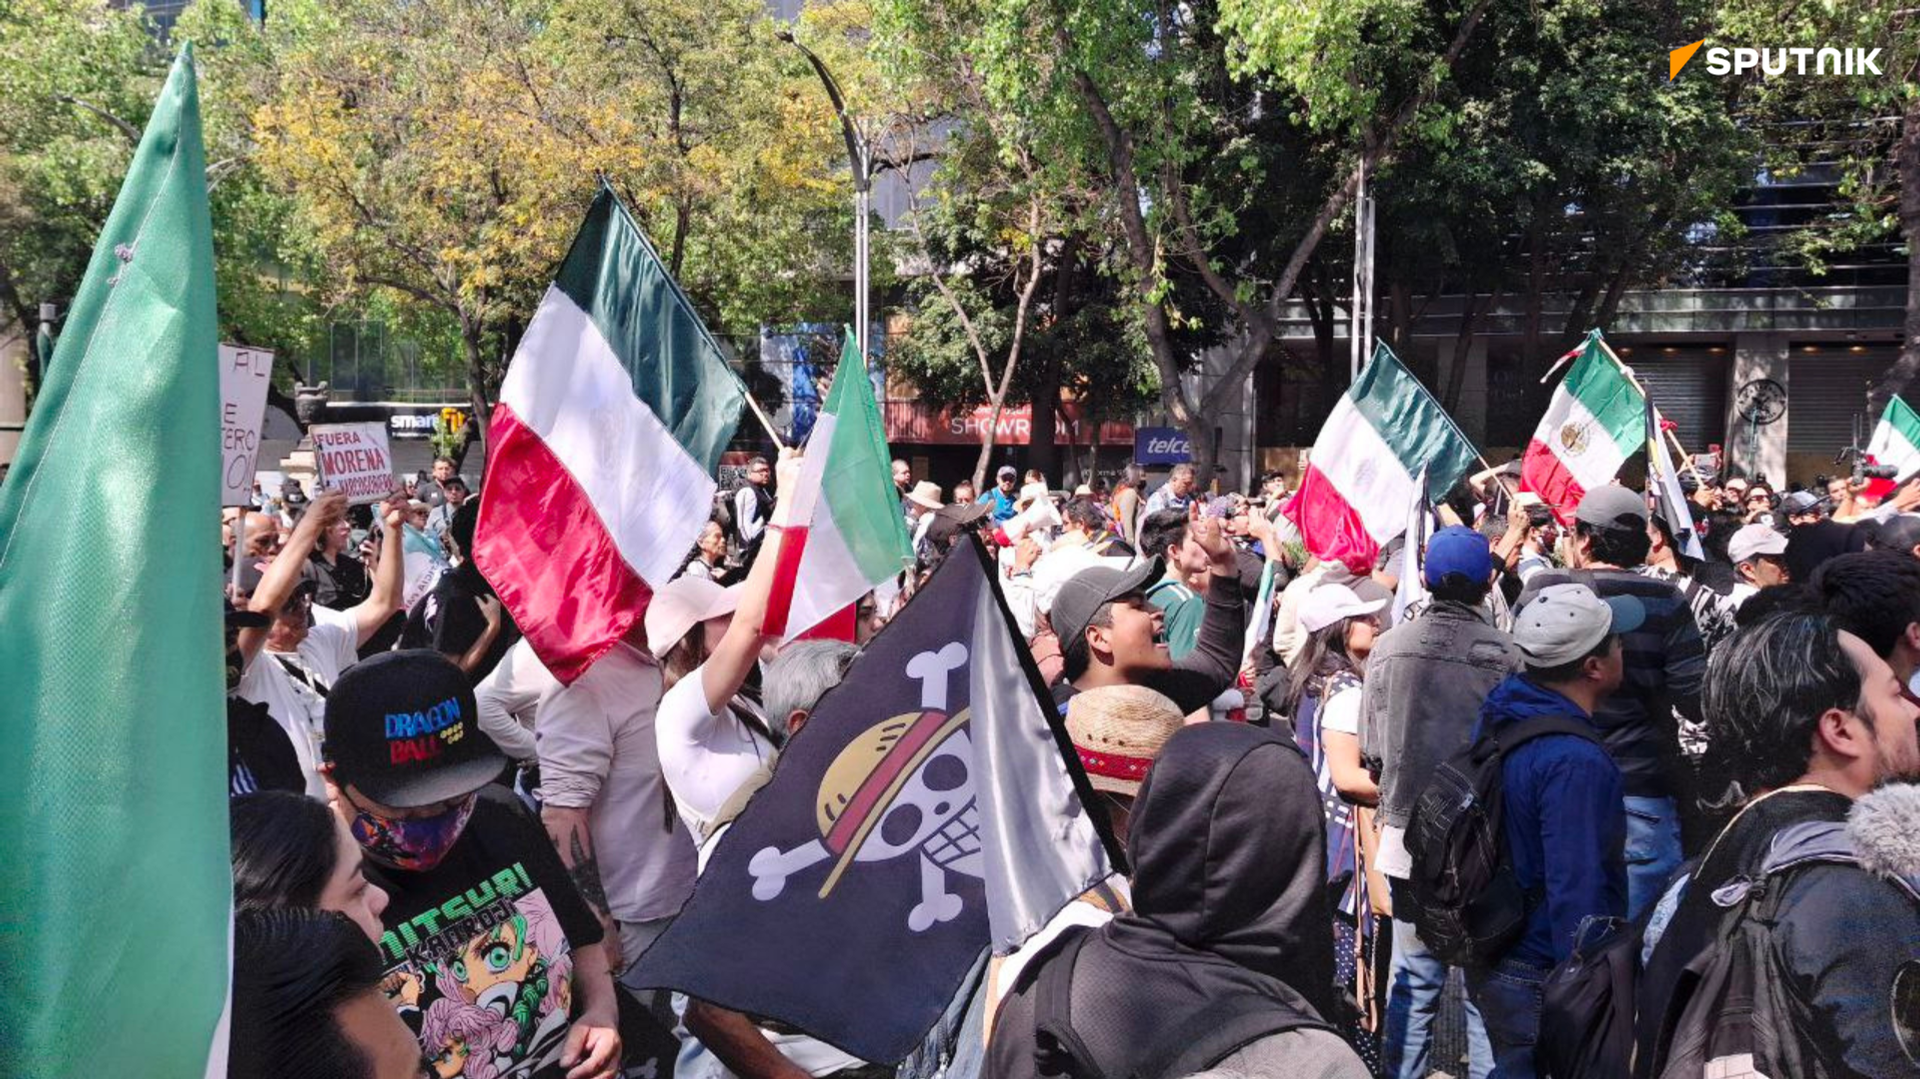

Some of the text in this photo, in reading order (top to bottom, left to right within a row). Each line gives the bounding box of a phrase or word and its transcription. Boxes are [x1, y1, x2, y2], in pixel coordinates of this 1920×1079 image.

[1147, 436, 1190, 454] telce
[321, 447, 386, 475] MORENA
[384, 696, 462, 739] DRAGON
